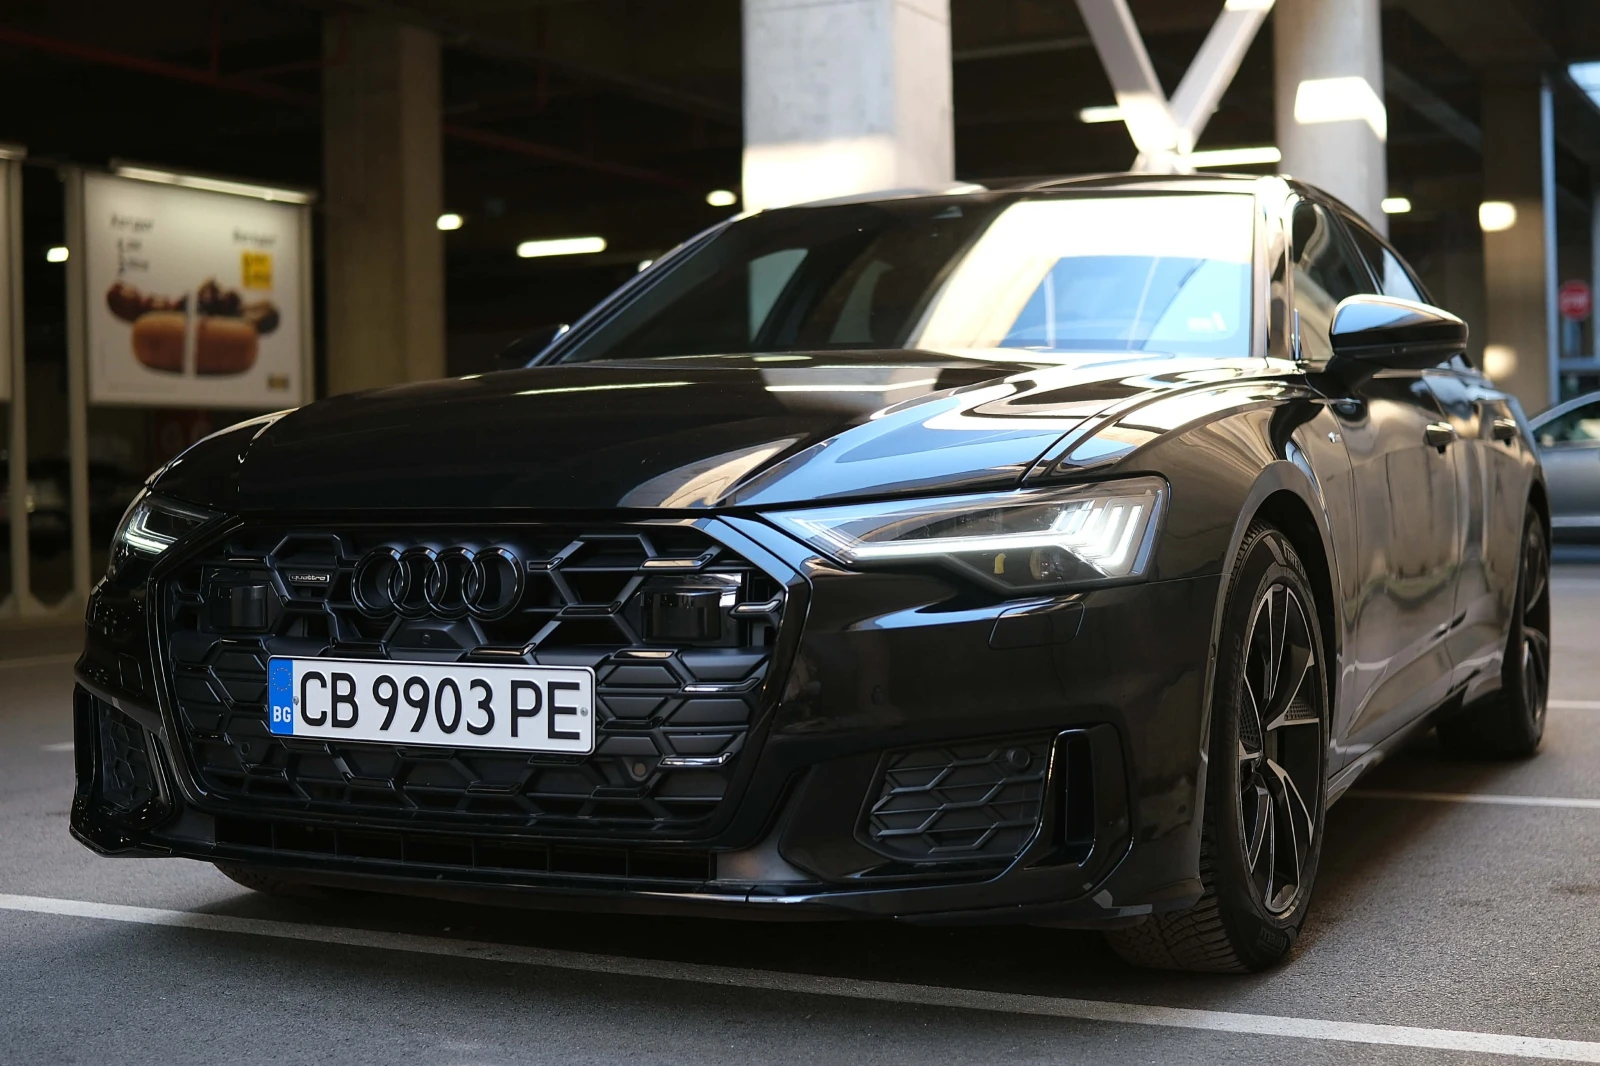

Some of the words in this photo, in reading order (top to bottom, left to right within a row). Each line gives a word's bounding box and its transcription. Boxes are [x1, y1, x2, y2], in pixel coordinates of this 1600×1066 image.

[273, 706, 291, 723] BG
[300, 671, 359, 728] CB
[372, 675, 495, 736] 9903
[510, 679, 581, 740] PE
